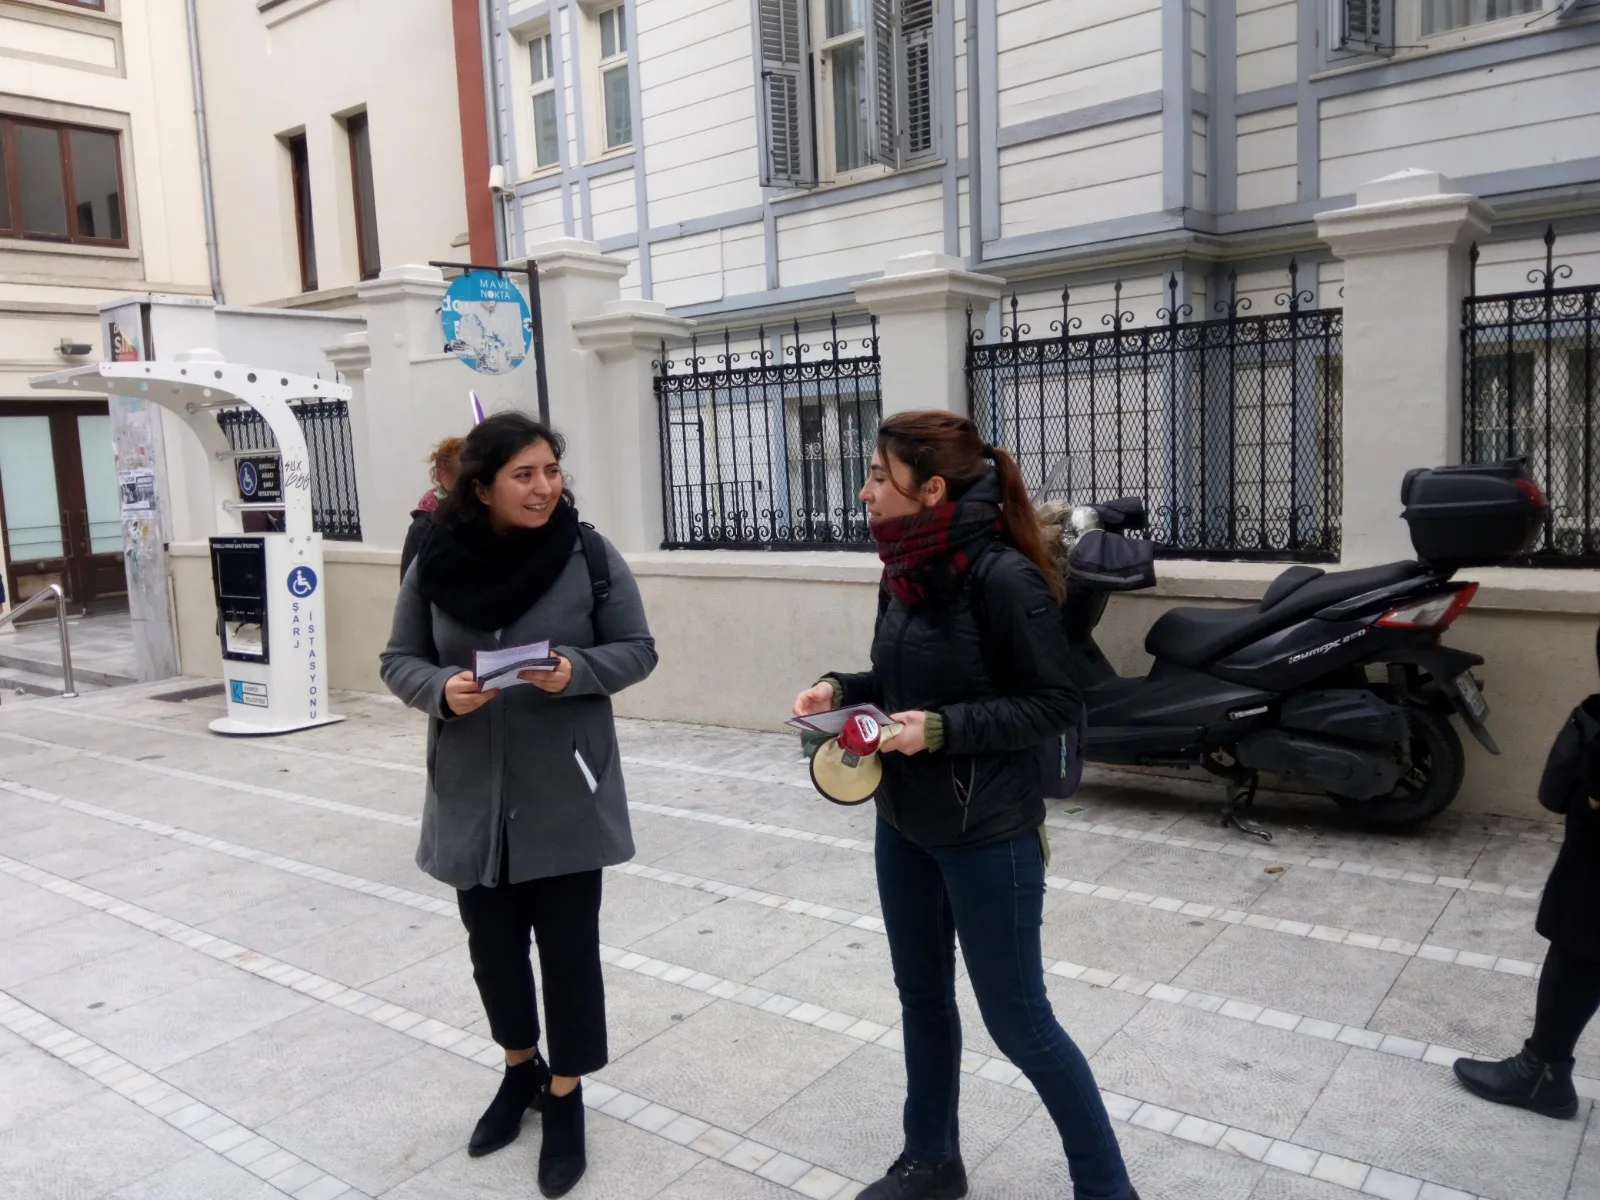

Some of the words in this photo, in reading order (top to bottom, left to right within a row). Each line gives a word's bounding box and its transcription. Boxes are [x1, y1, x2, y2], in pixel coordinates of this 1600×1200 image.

[480, 290, 511, 300] NOKTA
[292, 602, 300, 649] ŞARJ
[307, 610, 317, 719] İSTASYONU
